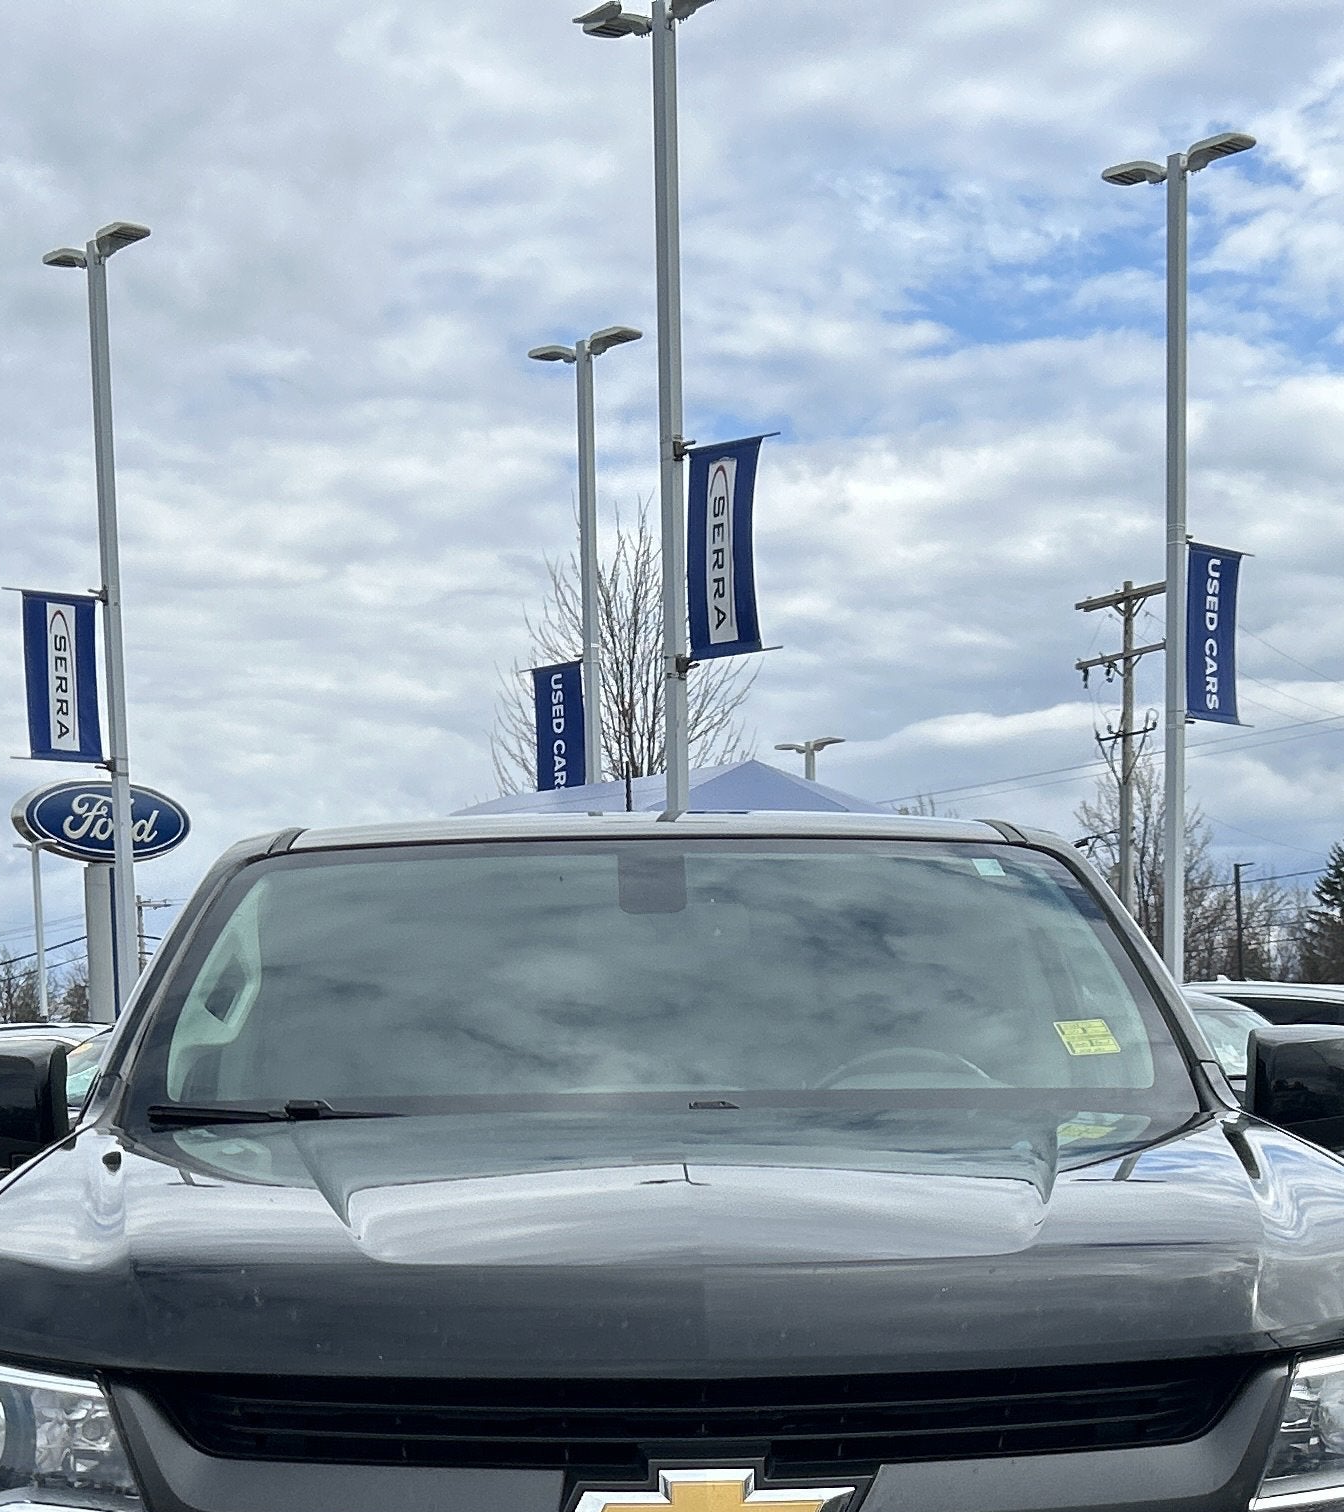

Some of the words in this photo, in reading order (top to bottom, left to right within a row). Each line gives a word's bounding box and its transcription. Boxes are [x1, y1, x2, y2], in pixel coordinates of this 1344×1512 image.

[712, 496, 727, 630] SERRA
[1206, 558, 1222, 631] USED
[54, 634, 70, 740] SERRA
[550, 673, 565, 734] USED
[1204, 638, 1219, 711] CARS
[553, 739, 567, 790] CAR
[62, 793, 160, 843] Fod
